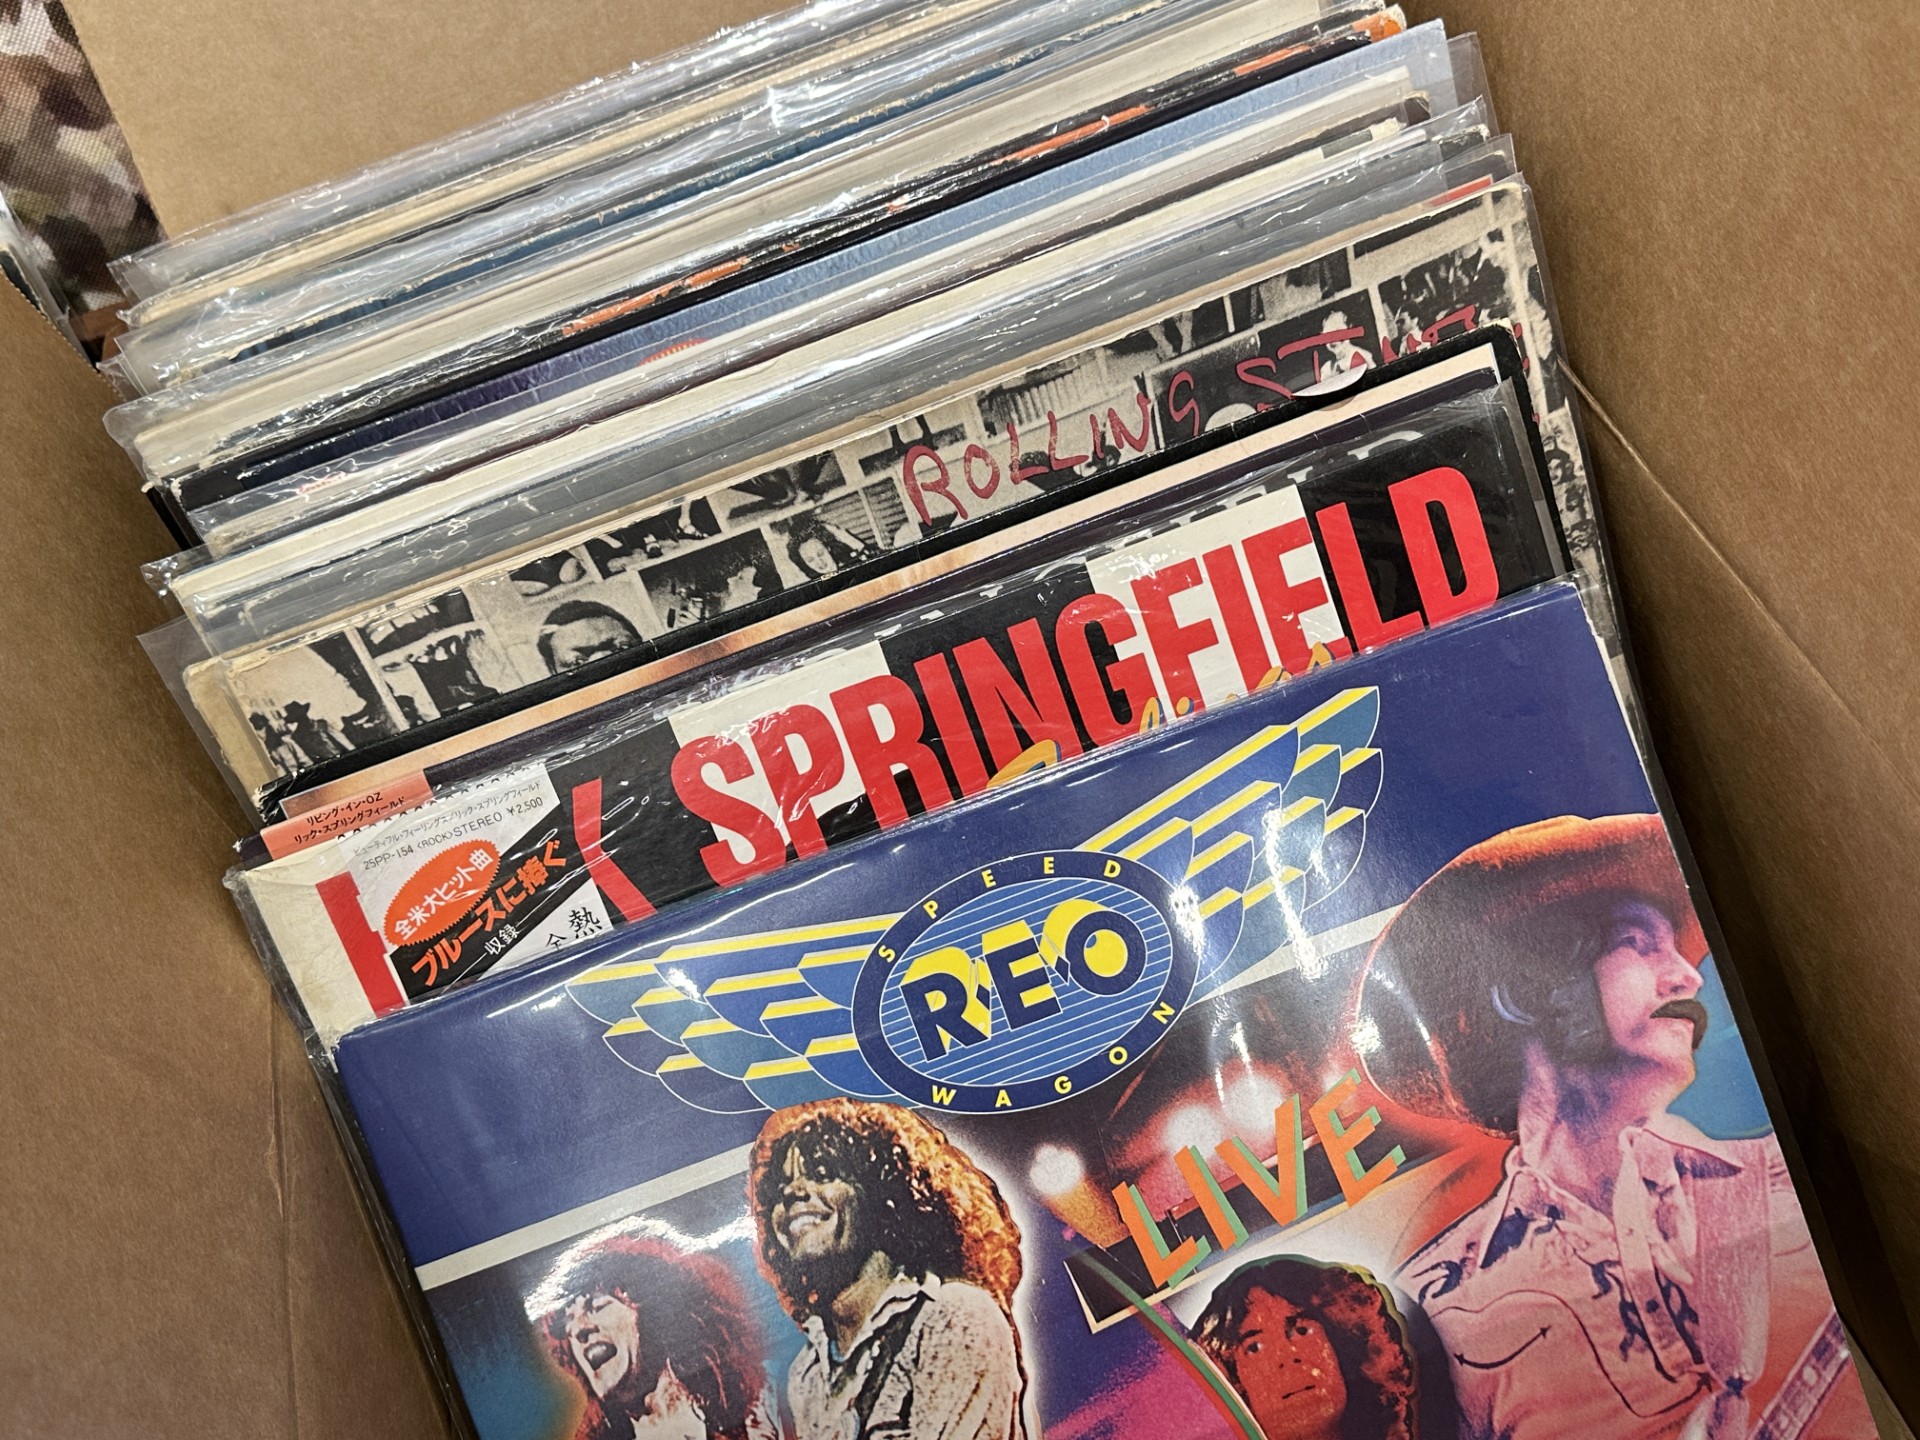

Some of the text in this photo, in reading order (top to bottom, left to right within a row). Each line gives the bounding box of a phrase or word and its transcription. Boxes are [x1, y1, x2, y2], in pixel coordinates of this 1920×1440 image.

[903, 371, 1200, 525] ROLLING
[671, 467, 1499, 889] SPRINGFIELD
[506, 796, 543, 818] ¥2,500
[394, 847, 494, 941] 全米大ヒット曲
[484, 923, 520, 956] 収録
[878, 856, 1122, 963] SPEED
[900, 898, 1147, 1062] REO
[931, 1001, 1176, 1108] WAGON
[1111, 1067, 1407, 1290] LIVE
